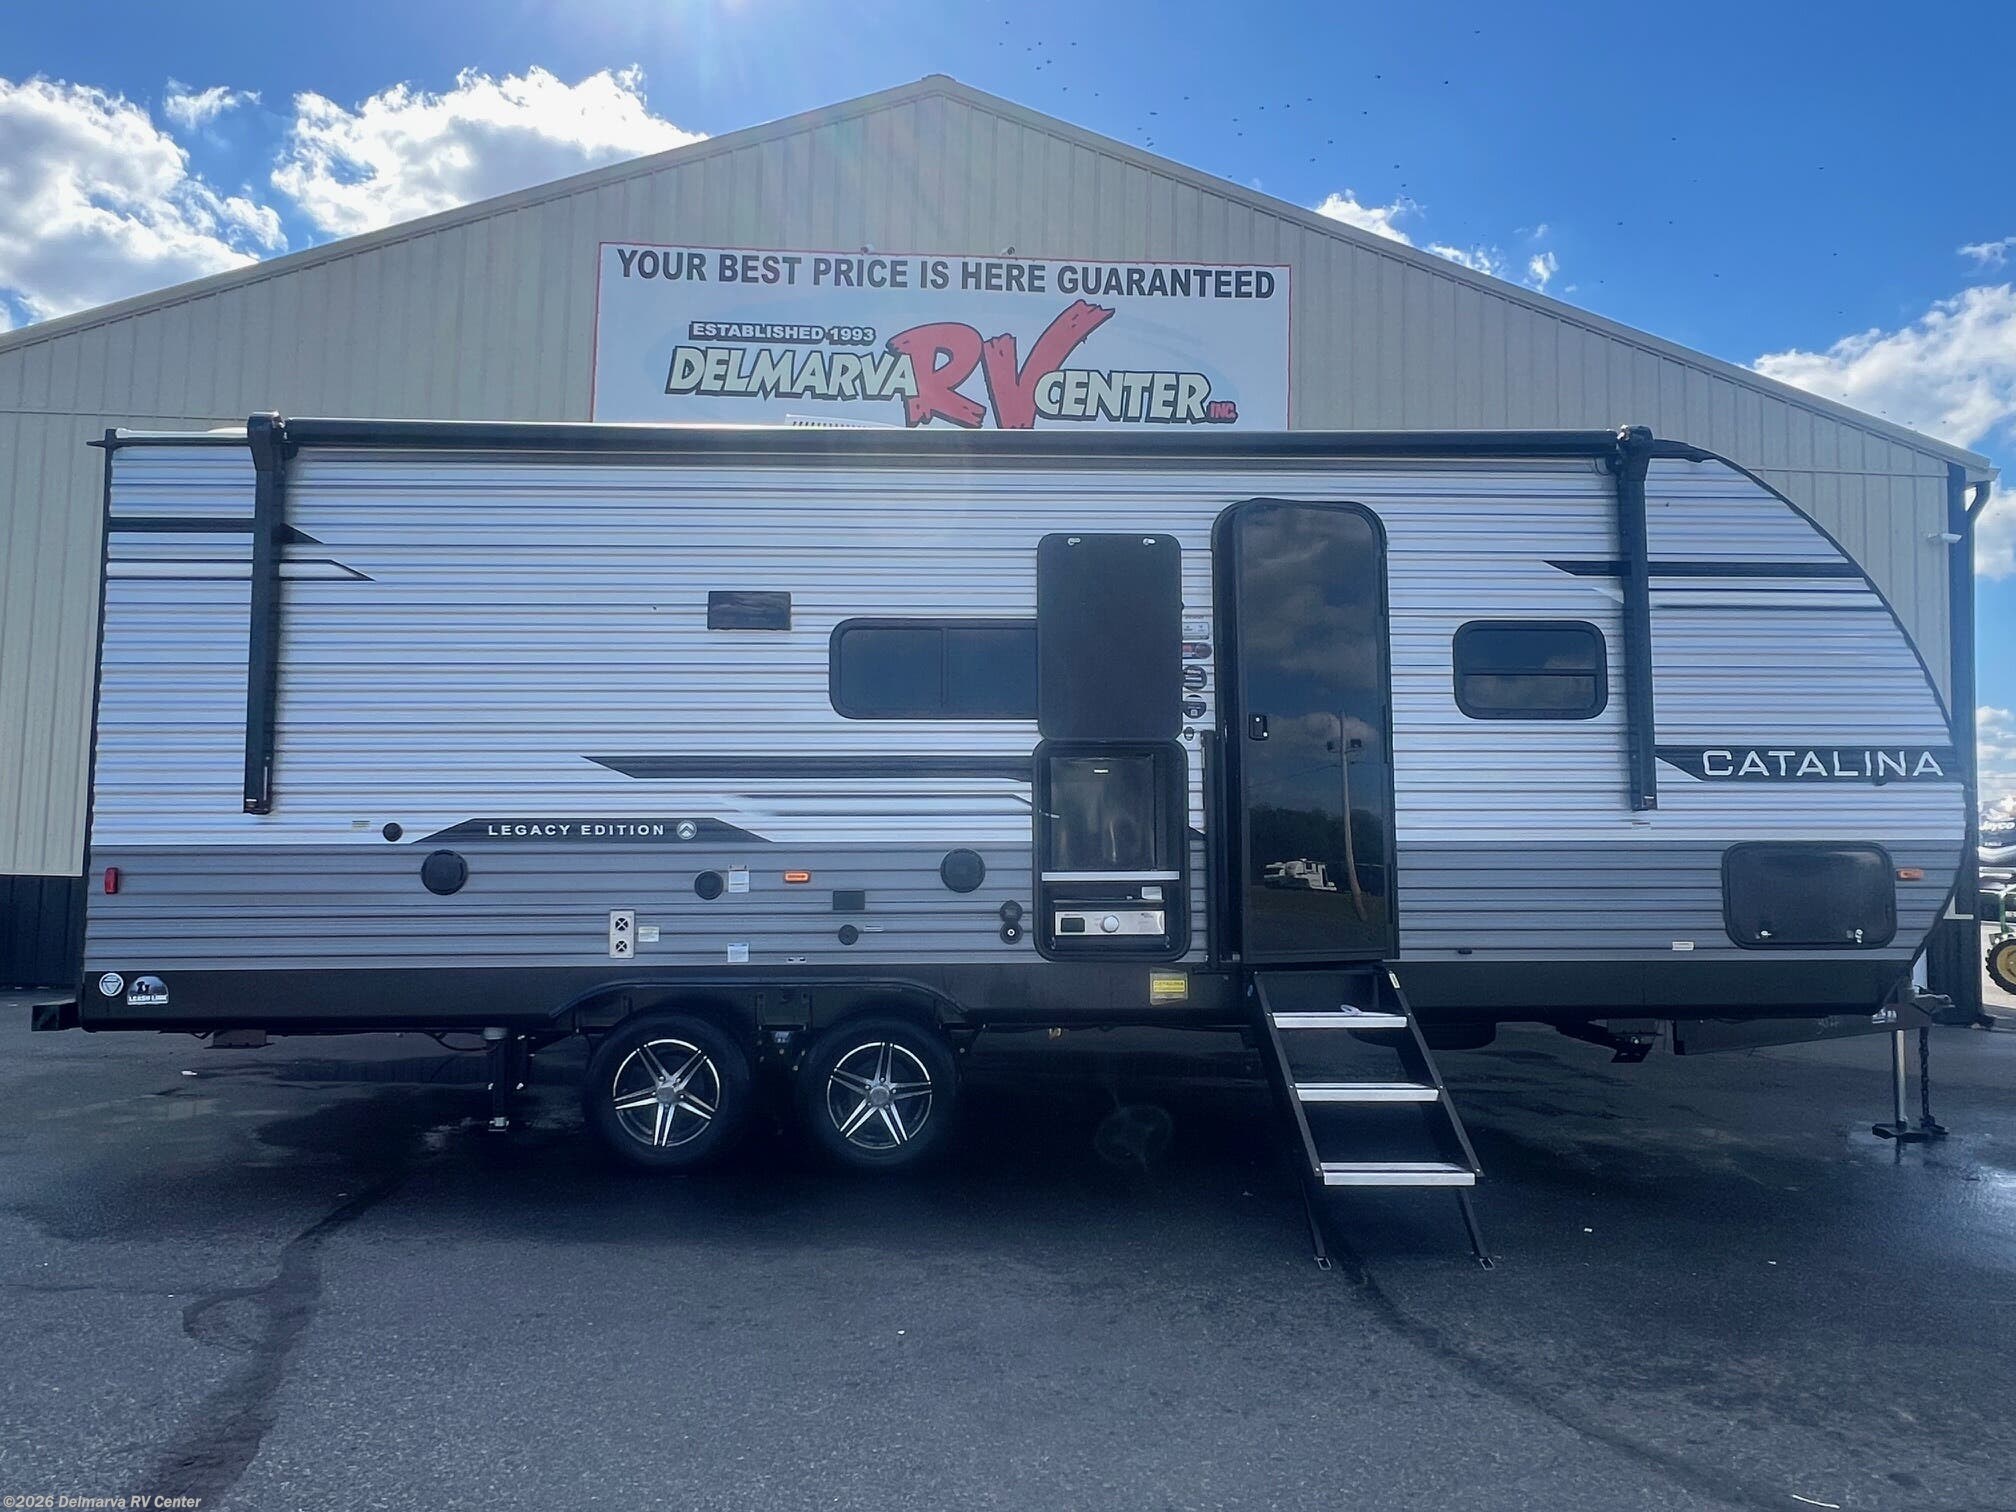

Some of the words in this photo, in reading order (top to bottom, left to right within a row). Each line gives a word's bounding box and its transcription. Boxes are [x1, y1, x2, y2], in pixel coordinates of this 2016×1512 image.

[616, 248, 707, 282] YOUR
[718, 254, 802, 285] BEST
[813, 258, 908, 288] PRICE
[920, 260, 950, 290] IS
[960, 262, 1046, 294] HERE
[1057, 266, 1276, 299] GUARANTEED
[692, 322, 825, 341] ESTABLISHED
[829, 325, 876, 343] 1993
[666, 346, 920, 400] DELMARVA
[886, 300, 1116, 430] RV
[1034, 369, 1212, 421] CENTER
[1702, 749, 1944, 777] CATALINA
[487, 824, 571, 837] LEGACY
[580, 824, 666, 837] EDITION
